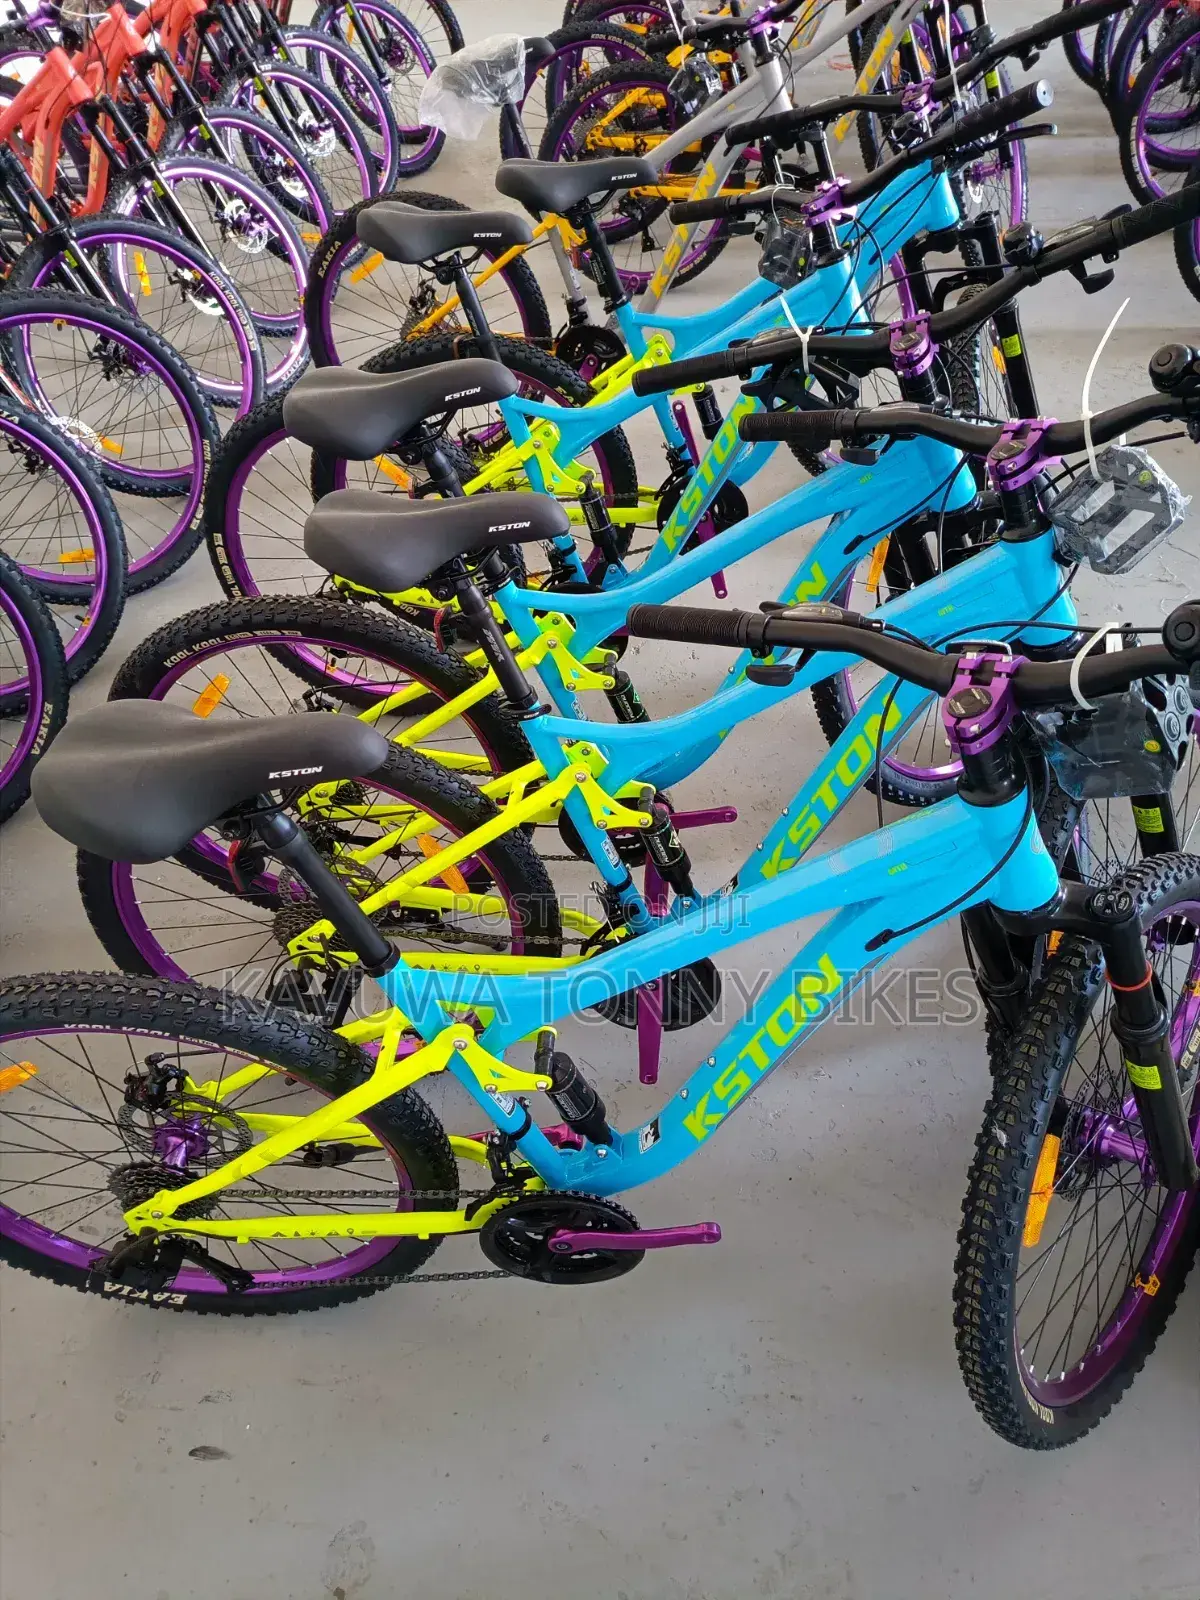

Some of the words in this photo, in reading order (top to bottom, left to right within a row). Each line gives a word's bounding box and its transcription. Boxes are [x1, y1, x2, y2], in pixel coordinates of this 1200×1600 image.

[611, 172, 638, 182] KSTON
[473, 231, 502, 239] KSTON
[444, 386, 482, 402] KSTON
[662, 393, 756, 553] KSTON
[488, 520, 531, 533] KSTON
[399, 602, 421, 617] KOO
[163, 647, 194, 668] KOOL
[192, 637, 226, 653] KOOL
[31, 702, 54, 756] EAKIA
[268, 765, 324, 780] KSTON
[759, 692, 903, 881] KSTON
[682, 952, 843, 1142] KSTON
[103, 1281, 188, 1305] EAKIA
